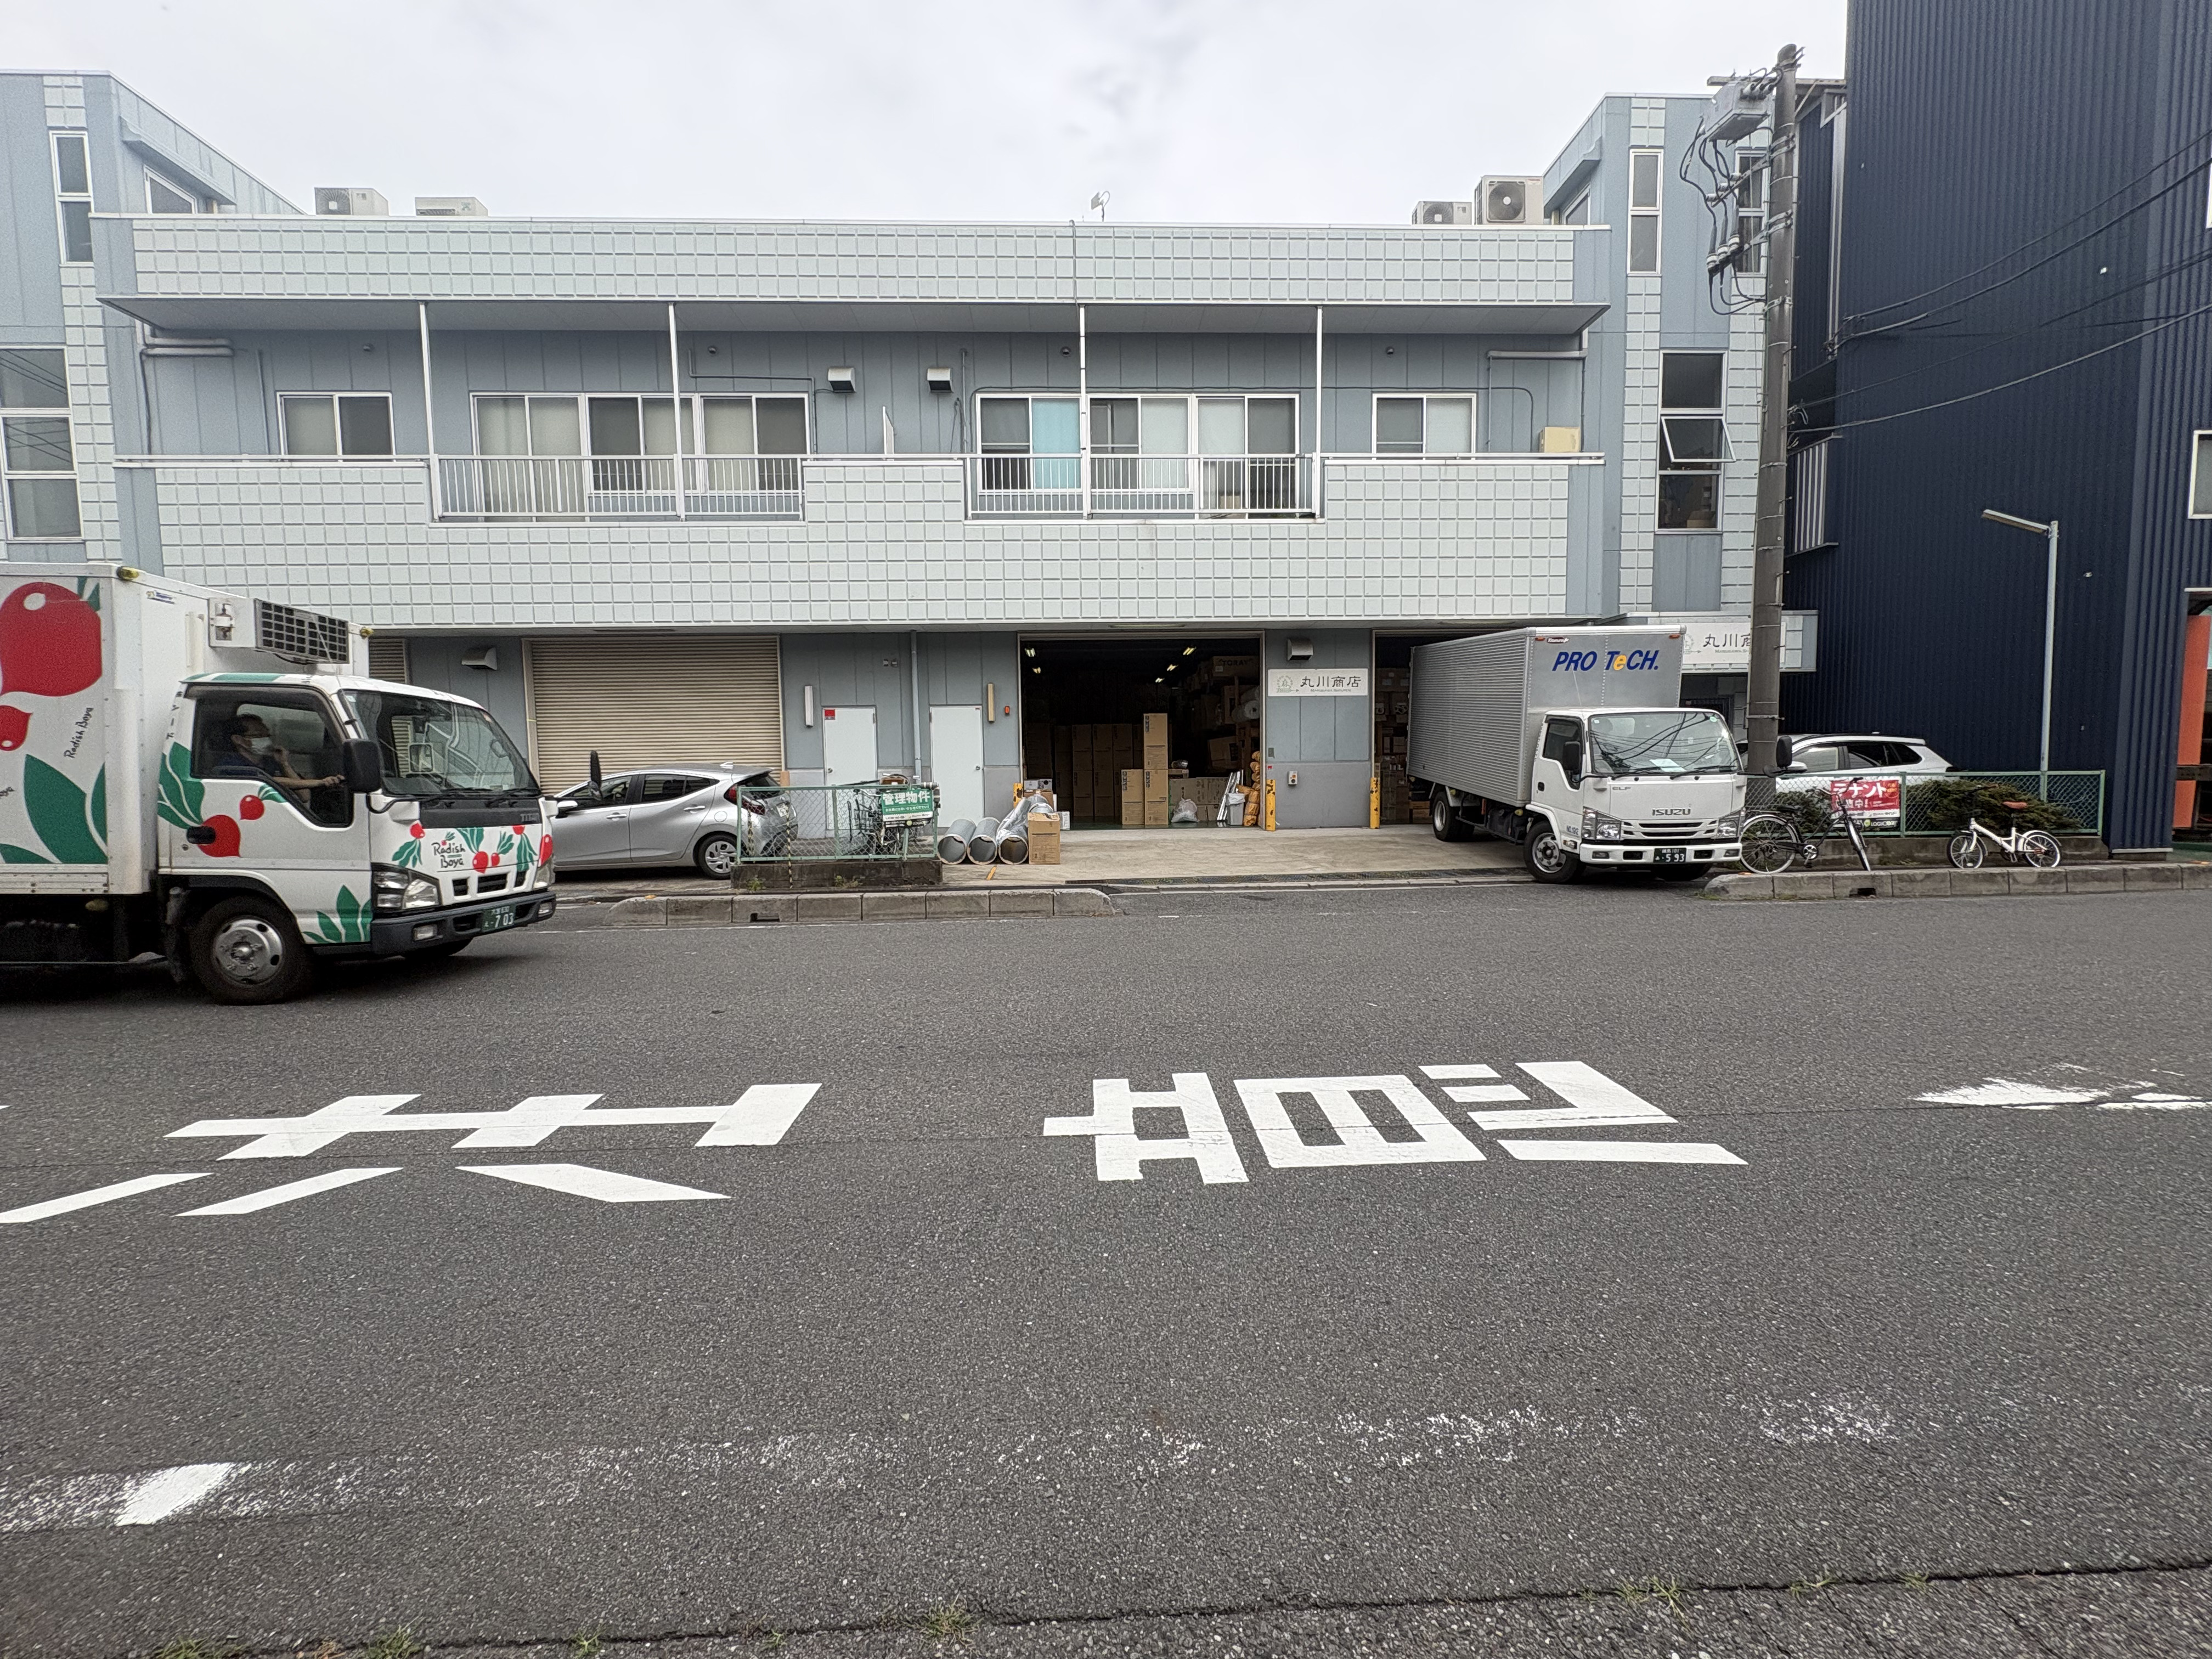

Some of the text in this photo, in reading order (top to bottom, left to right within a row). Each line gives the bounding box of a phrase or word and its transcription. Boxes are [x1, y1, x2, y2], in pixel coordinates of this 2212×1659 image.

[1702, 633, 1751, 648] 丸川商
[1552, 651, 1598, 672] PRO
[1300, 675, 1362, 688] 丸川商店
[64, 707, 94, 759] Radish Boya
[1832, 782, 1887, 798] テナント
[882, 790, 931, 806] 管理物件
[1652, 808, 1691, 816] ISUZU
[431, 842, 466, 856] Radish
[441, 854, 464, 868] Boya
